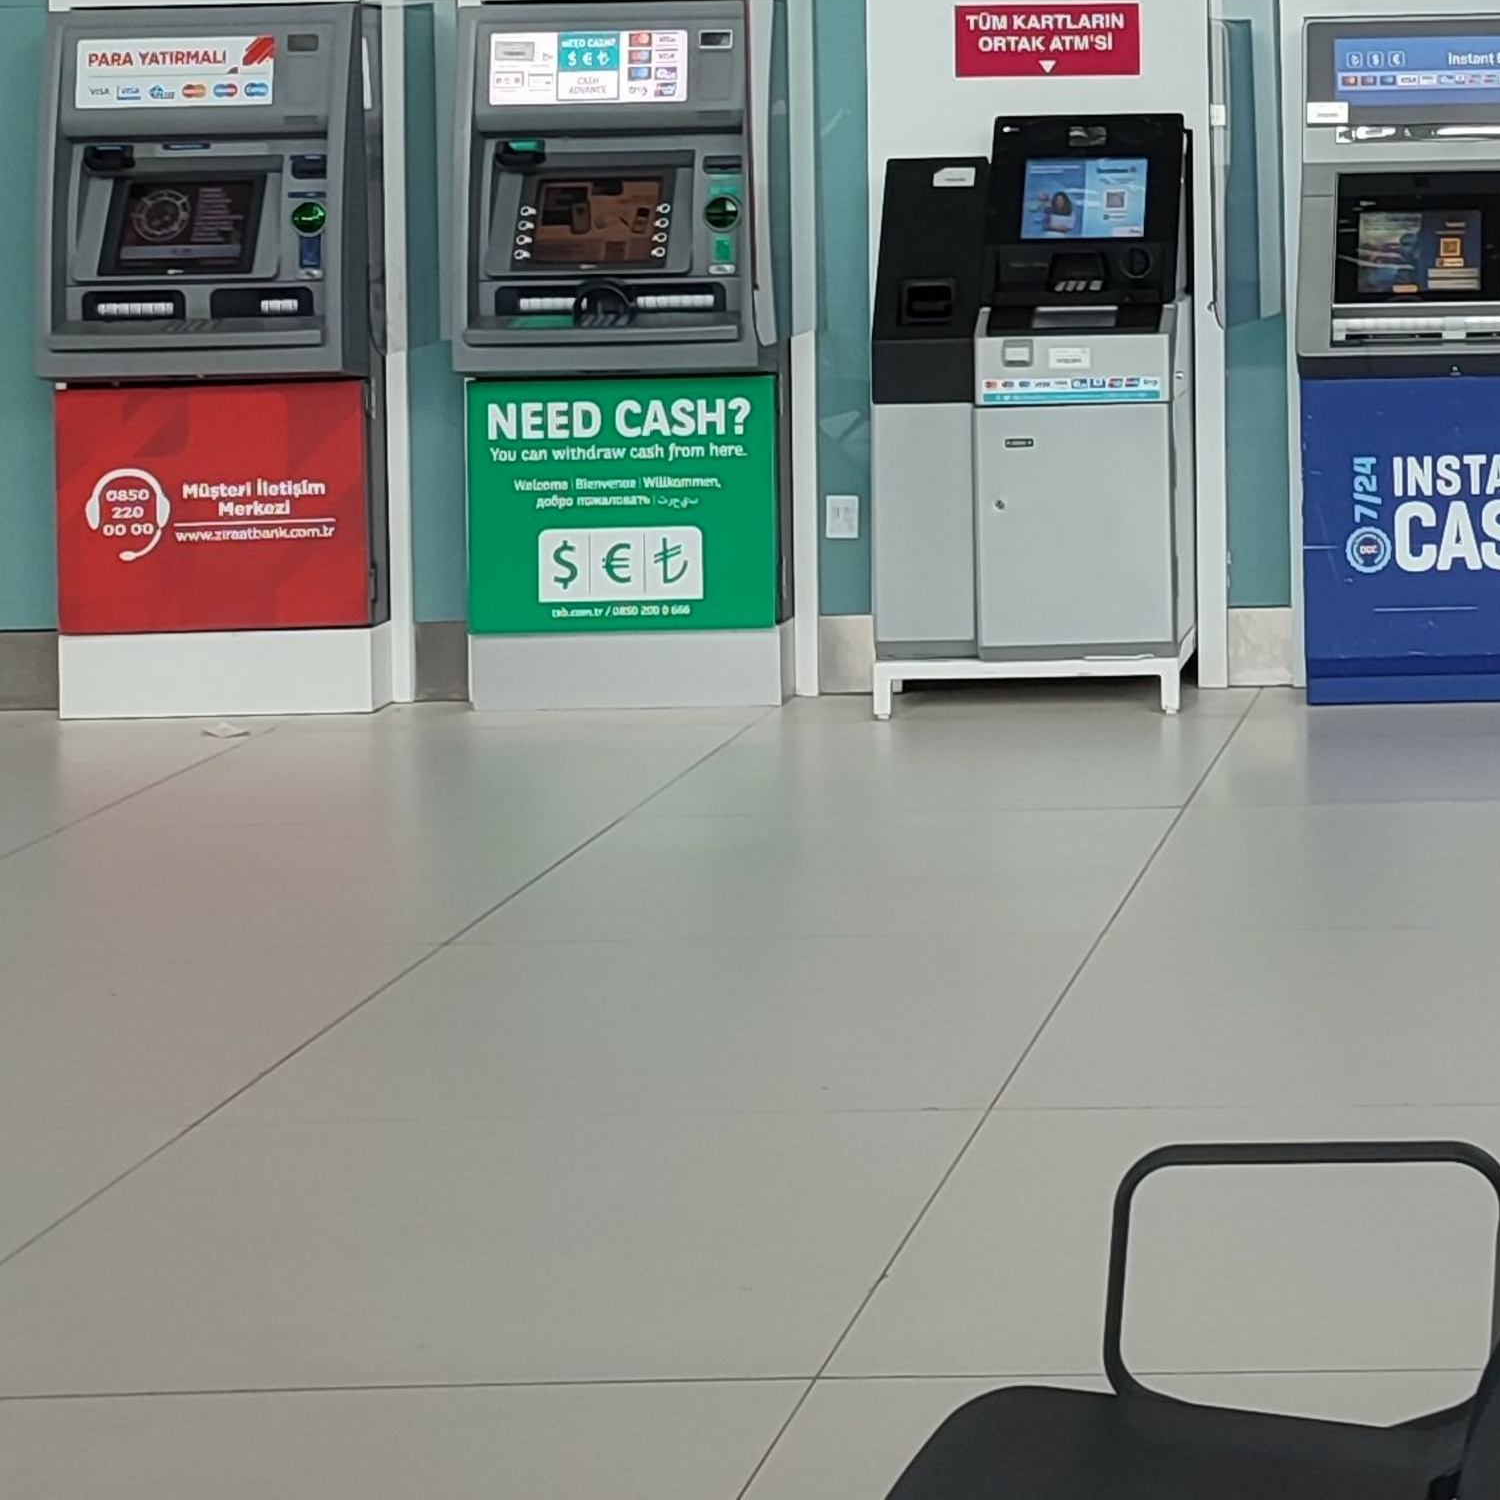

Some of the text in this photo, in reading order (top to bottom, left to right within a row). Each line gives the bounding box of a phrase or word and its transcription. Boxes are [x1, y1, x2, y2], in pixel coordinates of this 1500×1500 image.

[966, 12, 1124, 31] TÜM KARTLARIN
[978, 35, 1044, 52] ORTAK
[88, 50, 226, 67] PARA YATIRMALI
[1448, 52, 1494, 66] Instant
[487, 397, 751, 441] NEED CASH?
[490, 442, 748, 462] You can withdraw cash from here.
[183, 481, 251, 501] Müşteri
[514, 479, 569, 491] Welcome
[575, 478, 637, 490] Bienvenue
[1353, 456, 1382, 523] 7/24
[105, 488, 150, 502] 0850
[536, 495, 573, 510] добро
[576, 495, 651, 507] пожаловать
[111, 506, 145, 519] 220
[218, 499, 291, 517] Merkezi
[103, 523, 155, 536] 00 00
[175, 525, 335, 542] www.ziraatbank.com.tr
